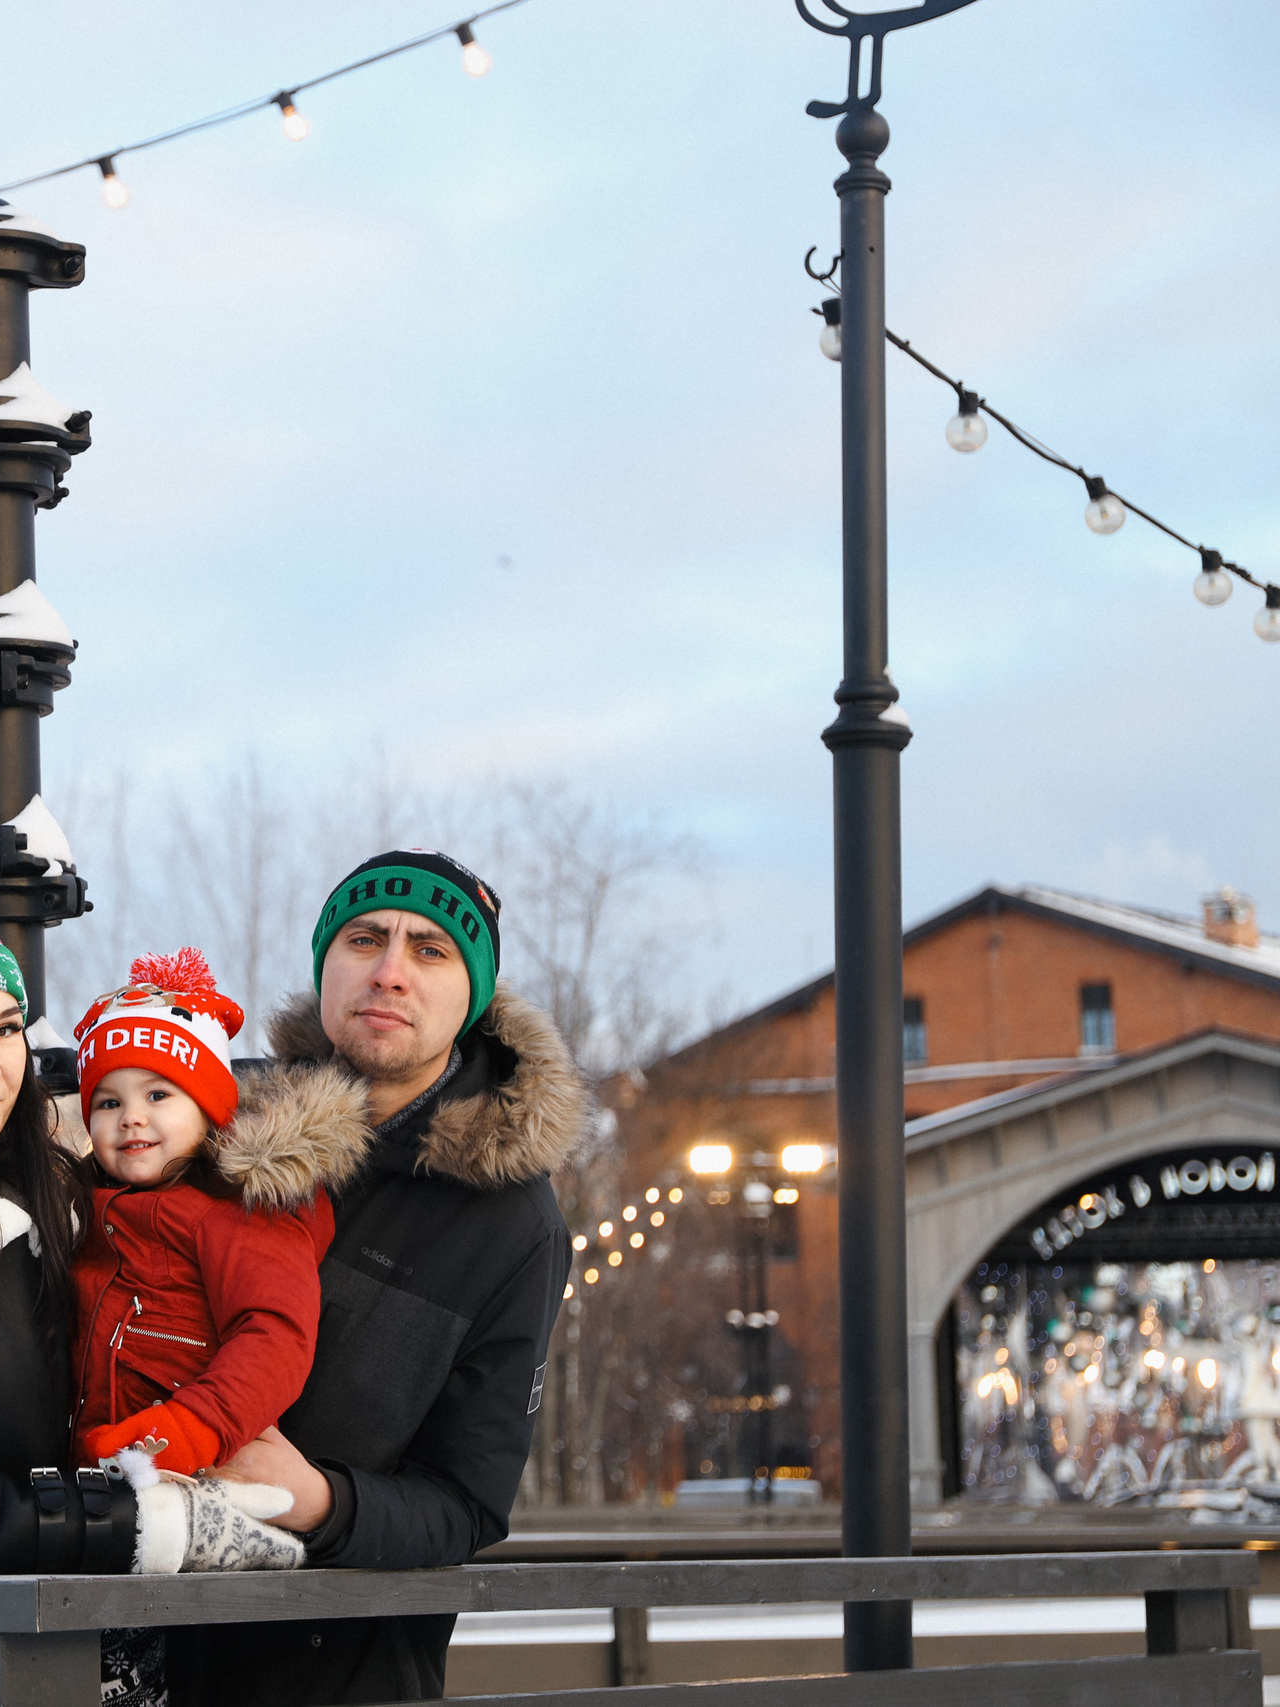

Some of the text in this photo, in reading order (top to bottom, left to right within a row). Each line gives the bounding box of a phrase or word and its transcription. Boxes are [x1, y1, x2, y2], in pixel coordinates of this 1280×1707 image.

[347, 877, 412, 907] HO
[428, 885, 480, 943] HO
[105, 1026, 199, 1071] DEER!
[361, 1247, 396, 1269] adidas
